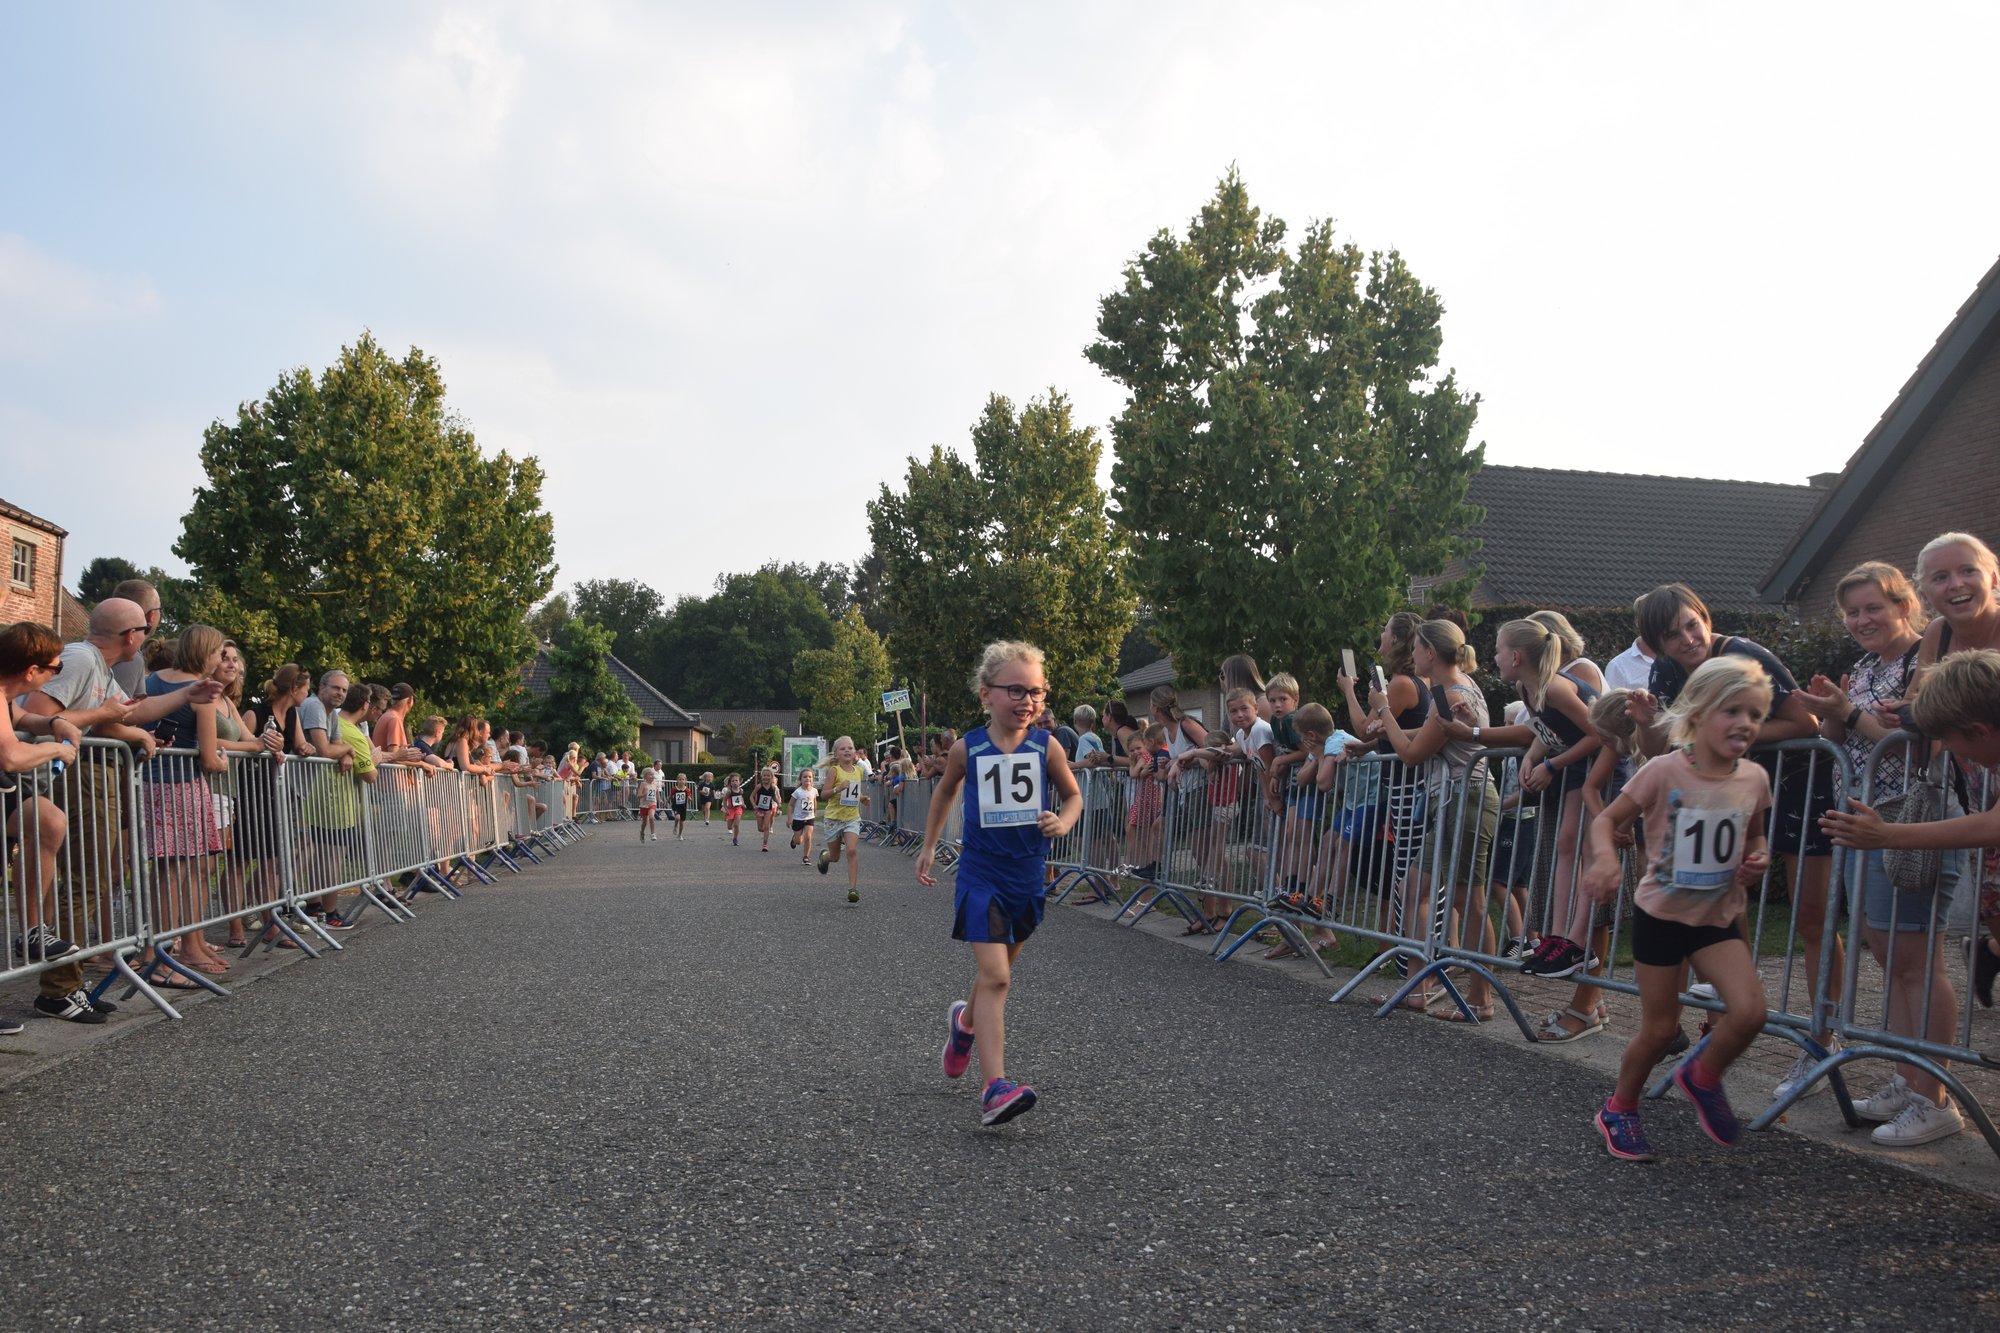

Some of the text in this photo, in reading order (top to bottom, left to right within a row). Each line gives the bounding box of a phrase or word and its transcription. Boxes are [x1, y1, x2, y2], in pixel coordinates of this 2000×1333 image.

[885, 695, 908, 707] START
[1534, 721, 1559, 745] 89
[984, 762, 1034, 804] 15
[648, 789, 656, 797] 23
[676, 793, 685, 801] 20
[845, 784, 859, 798] 14
[762, 796, 769, 805] 8
[802, 801, 813, 811] 22
[1684, 818, 1735, 864] 10
